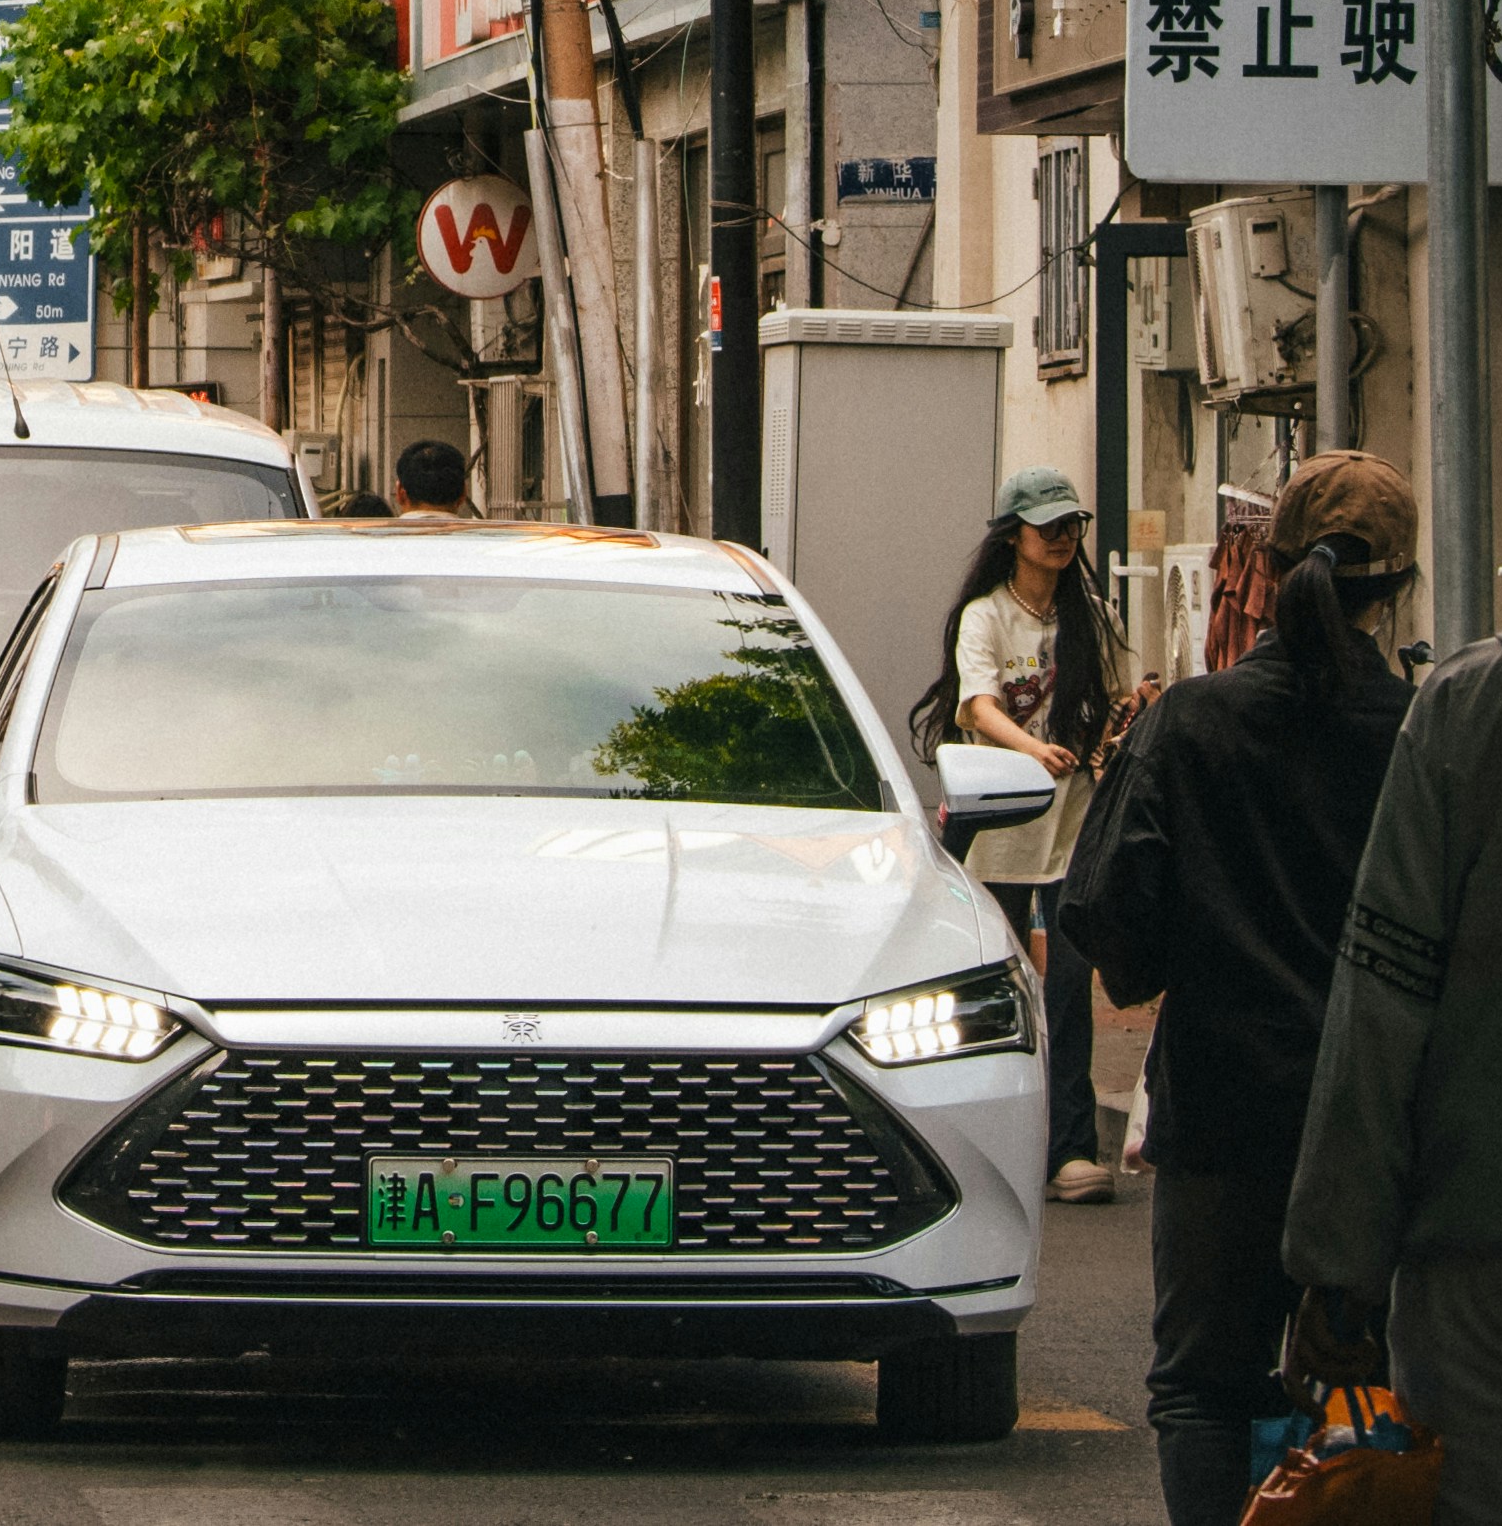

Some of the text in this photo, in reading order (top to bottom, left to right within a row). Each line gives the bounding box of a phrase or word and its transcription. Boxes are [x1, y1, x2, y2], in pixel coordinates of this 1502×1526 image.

[857, 161, 936, 184] 新华
[48, 273, 65, 286] Rd
[35, 304, 63, 319] 50m
